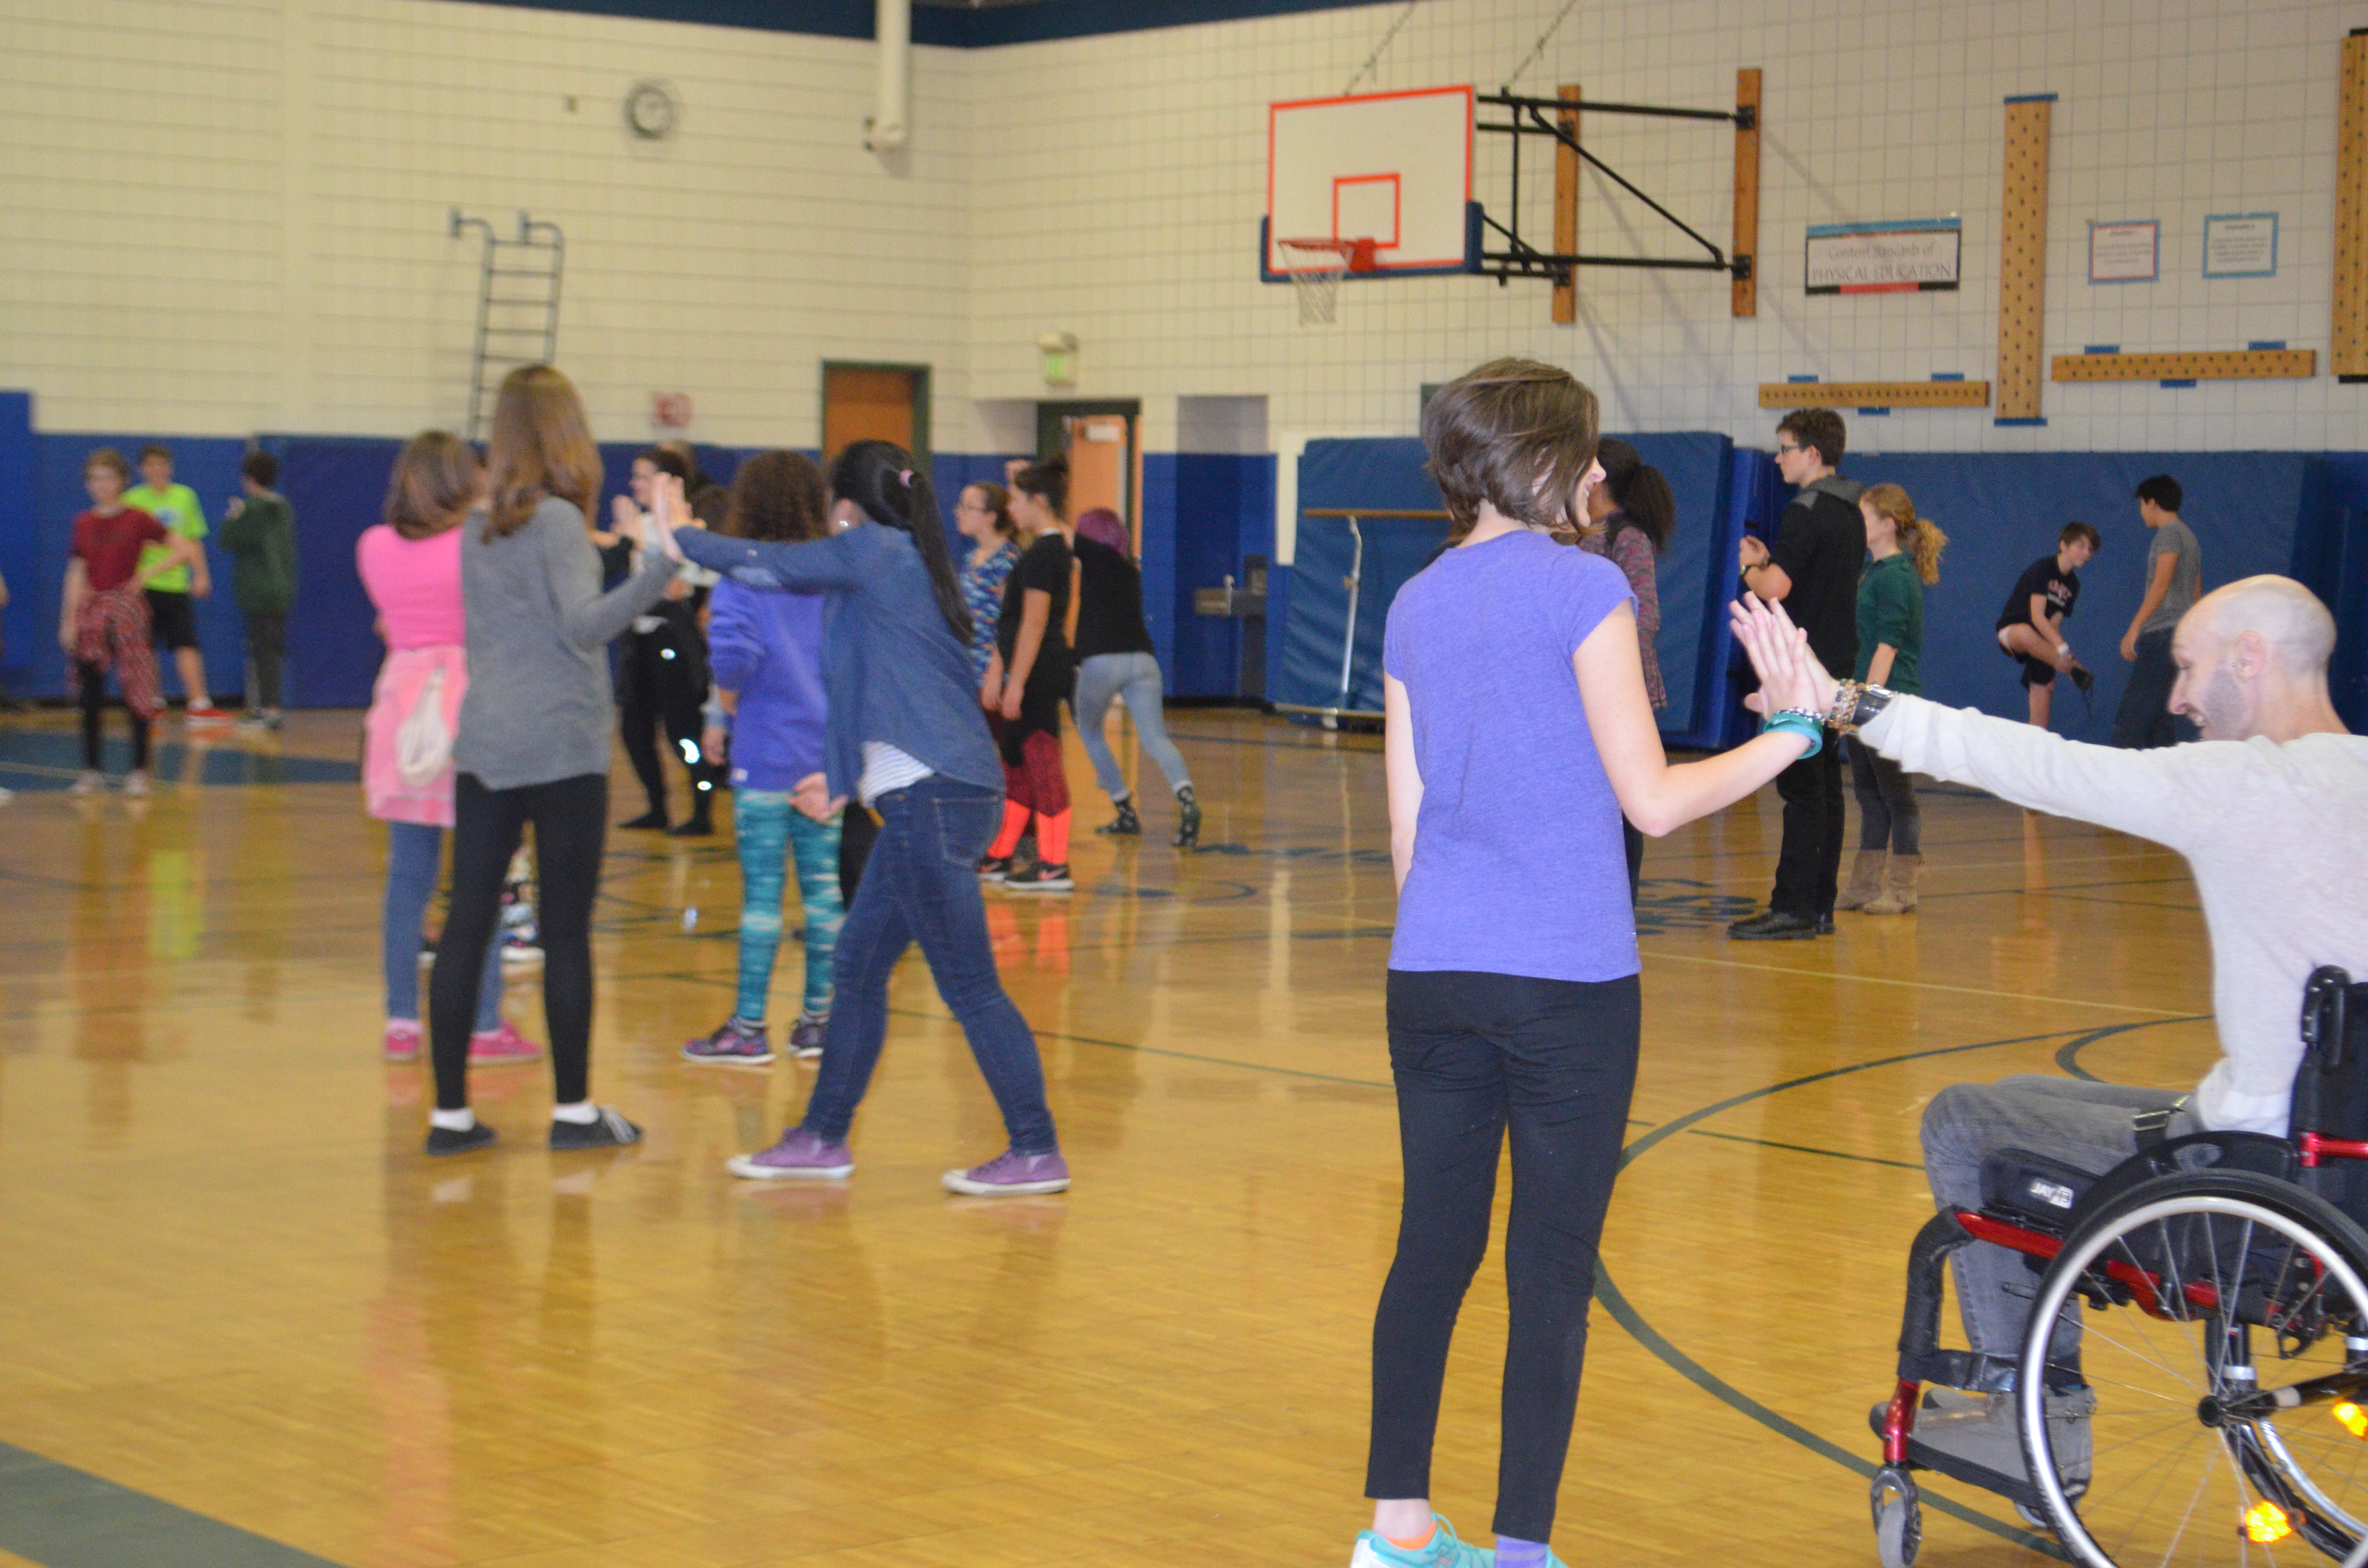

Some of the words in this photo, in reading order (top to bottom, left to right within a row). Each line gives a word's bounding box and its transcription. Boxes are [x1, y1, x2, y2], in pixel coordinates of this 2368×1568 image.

[1812, 265, 1867, 281] PHYSICAL
[1875, 263, 1951, 280] EDUCATION
[2031, 1182, 2056, 1198] JAY
